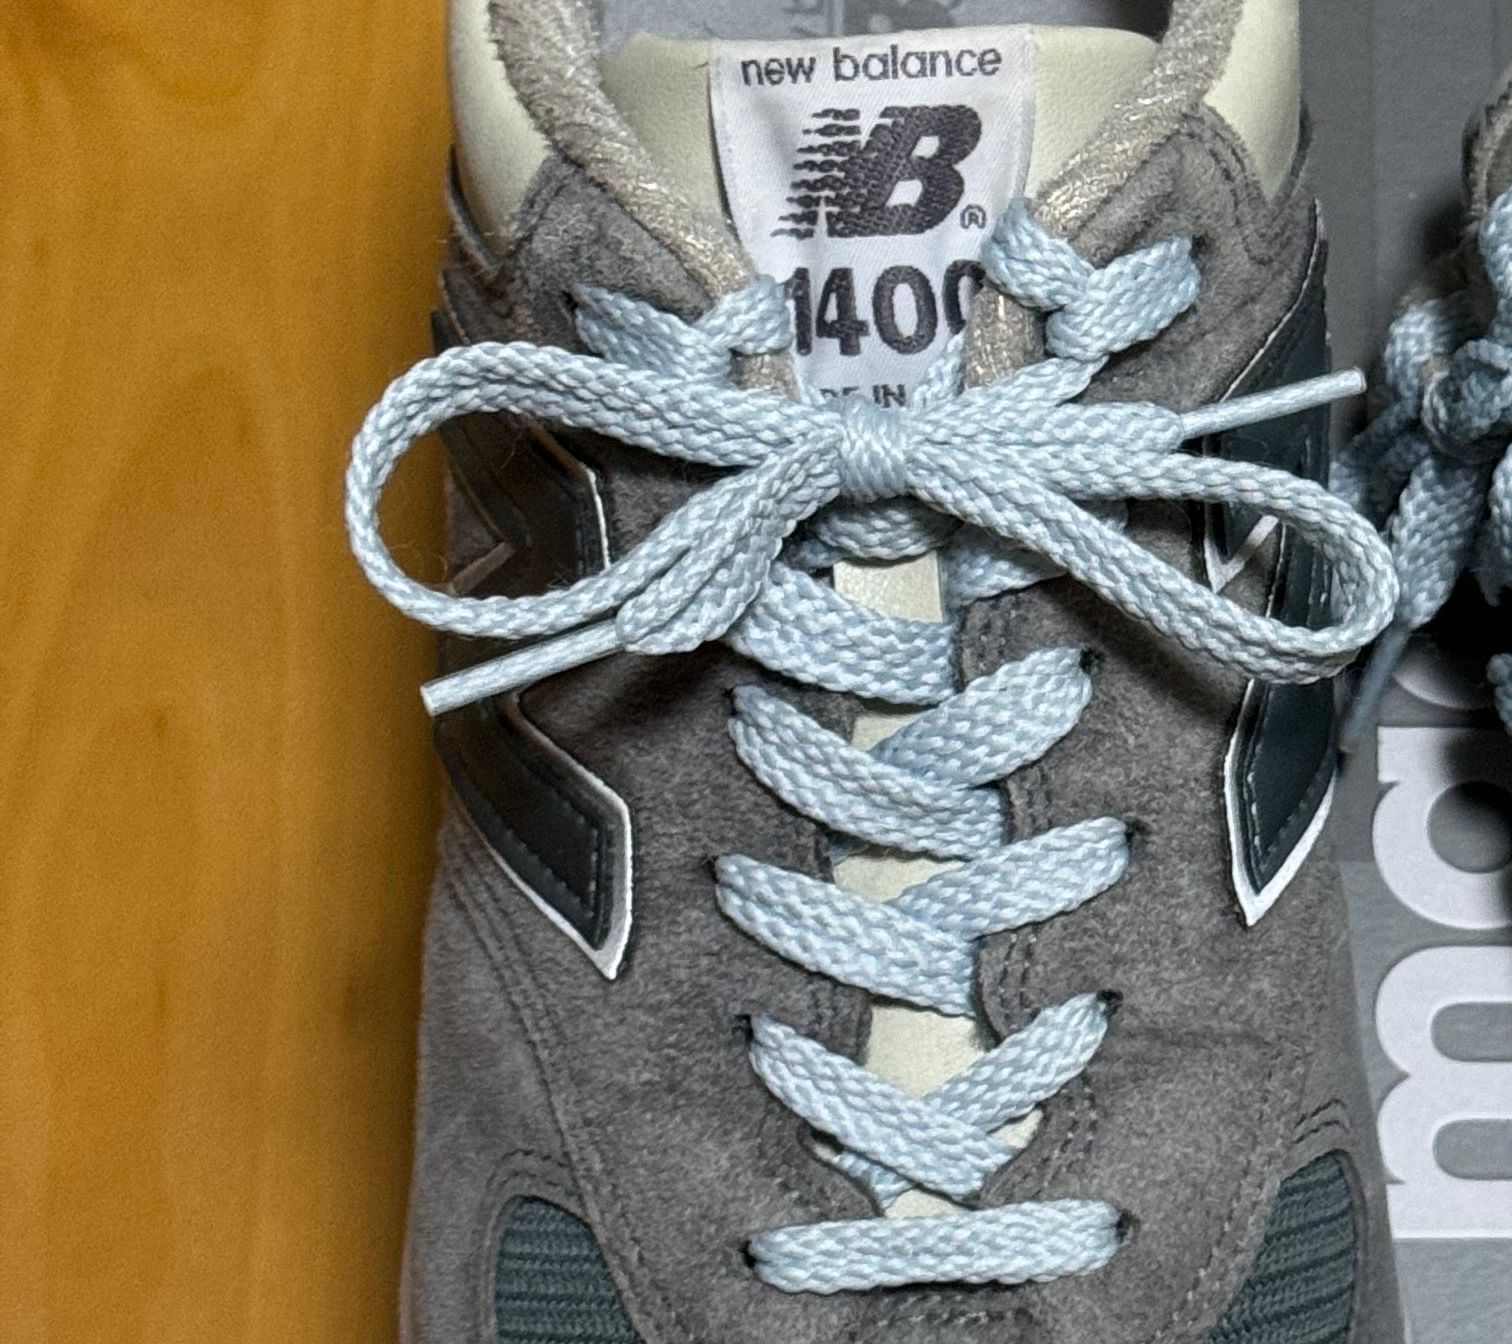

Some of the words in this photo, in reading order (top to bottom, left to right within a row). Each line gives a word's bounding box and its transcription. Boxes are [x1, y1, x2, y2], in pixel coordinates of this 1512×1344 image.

[741, 51, 816, 88] new
[833, 44, 1002, 83] balance
[786, 259, 986, 357] 1400
